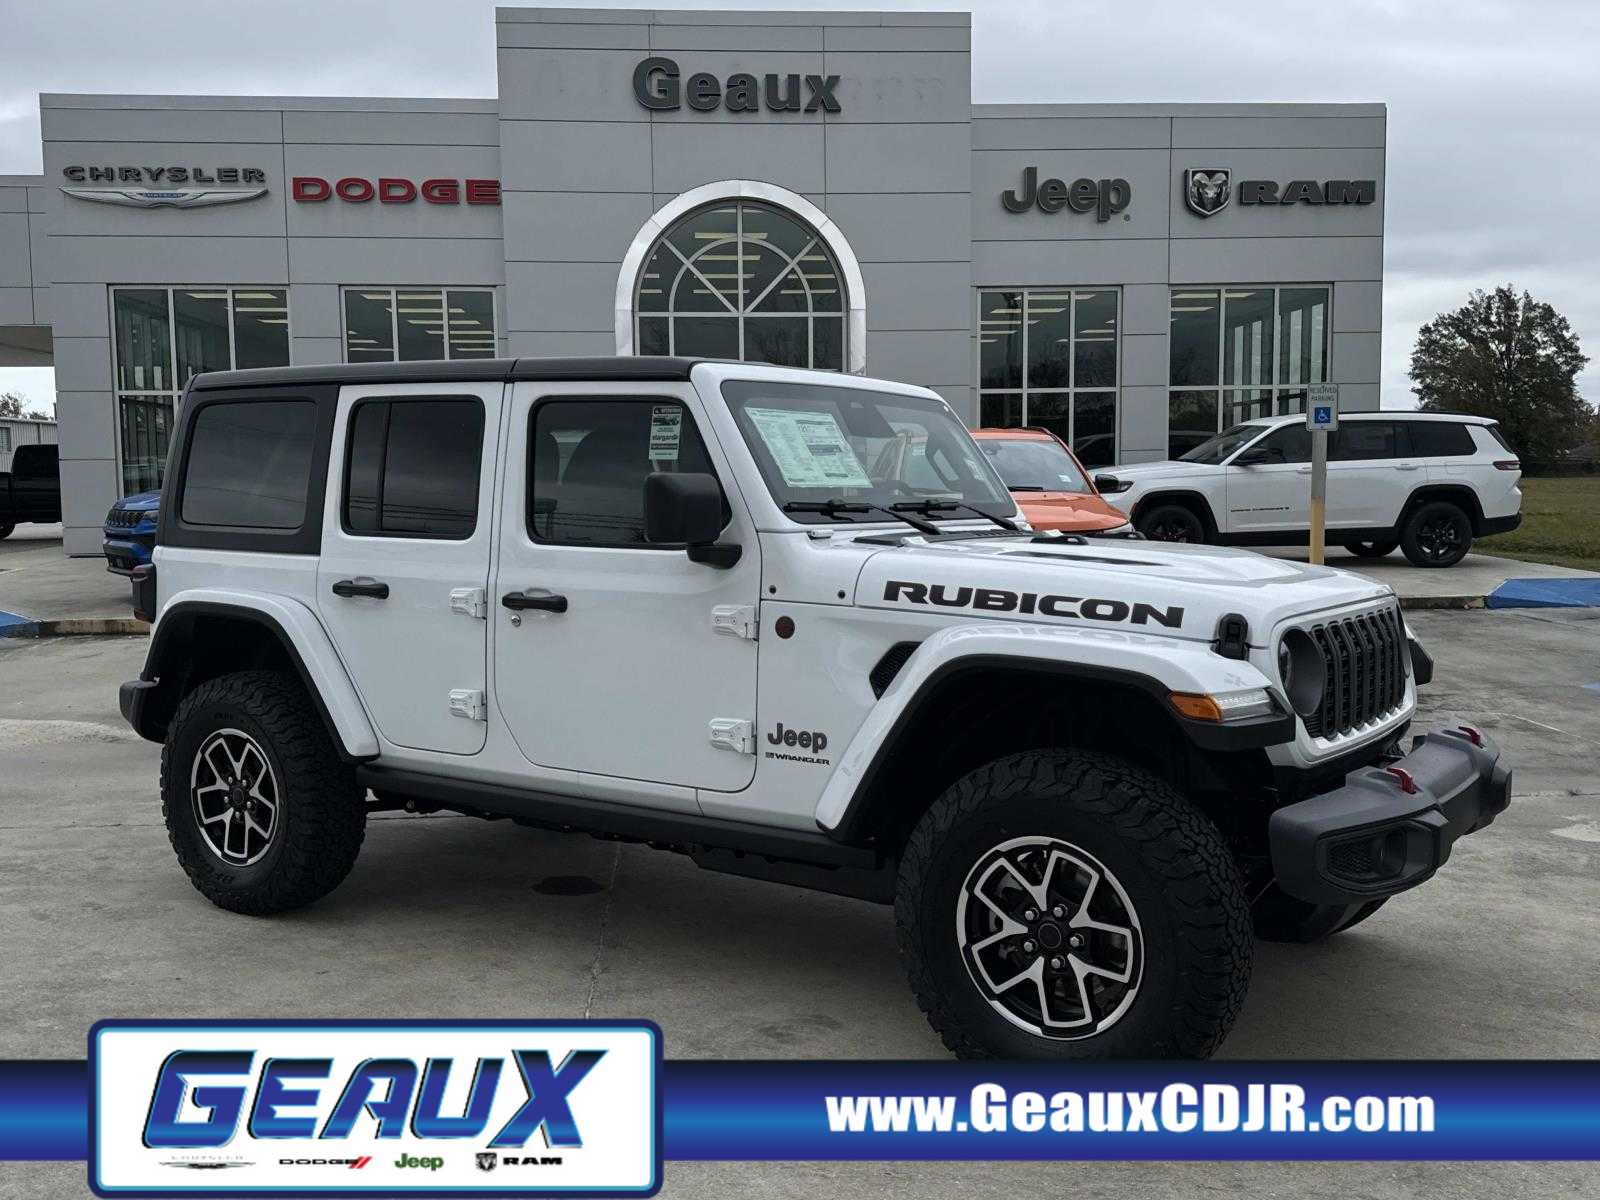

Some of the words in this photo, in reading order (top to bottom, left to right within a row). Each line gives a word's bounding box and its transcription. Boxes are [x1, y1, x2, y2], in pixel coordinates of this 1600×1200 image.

[632, 57, 841, 112] Geaux
[63, 166, 265, 183] CHRYSLER
[292, 177, 501, 205] DODGE
[1002, 166, 1132, 223] Jeep
[1239, 180, 1376, 206] RAM
[883, 580, 1184, 628] RUBICON
[767, 722, 828, 753] Jeep
[774, 752, 831, 766] WRANGLER
